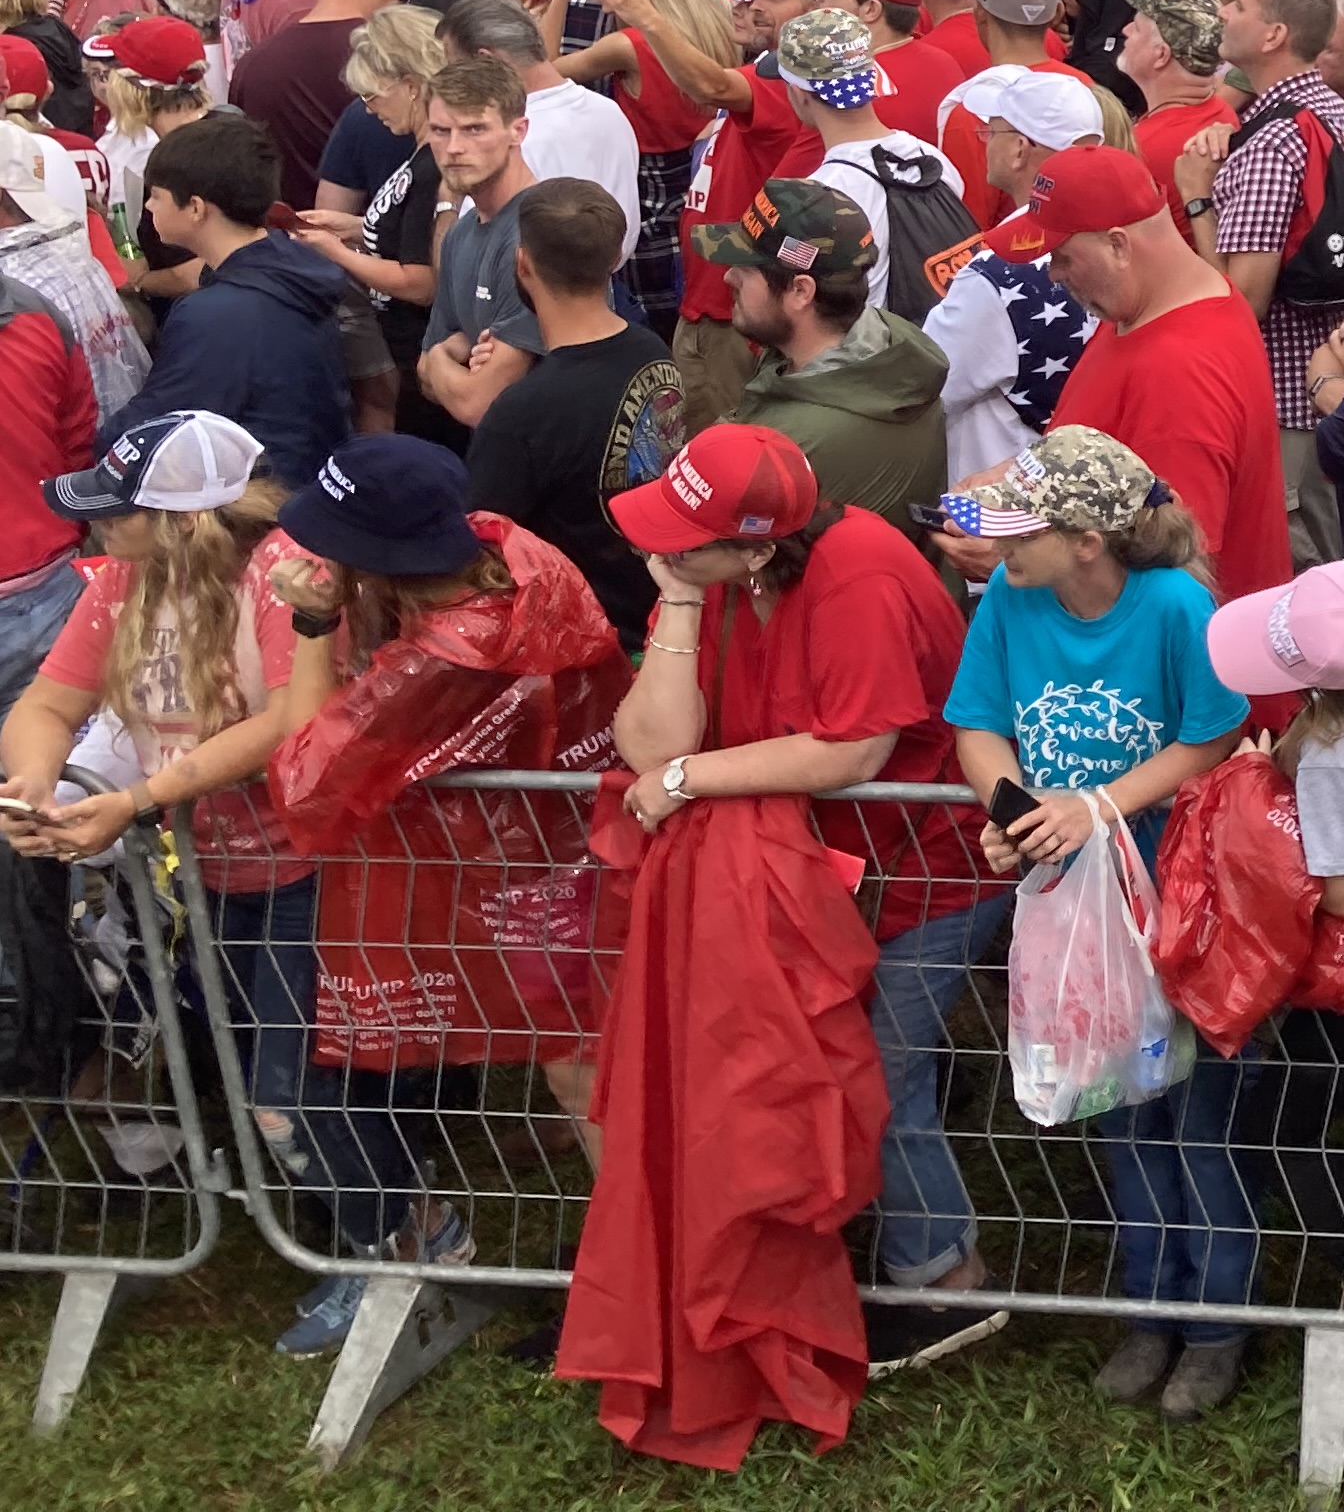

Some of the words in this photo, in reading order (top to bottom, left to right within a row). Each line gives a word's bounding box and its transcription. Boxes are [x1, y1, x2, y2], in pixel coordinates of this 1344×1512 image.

[827, 36, 871, 58] Trump
[671, 474, 703, 512] AGAIN!
[679, 457, 714, 502] AMERICA
[556, 727, 614, 768] TRUM
[1041, 742, 1129, 773] home
